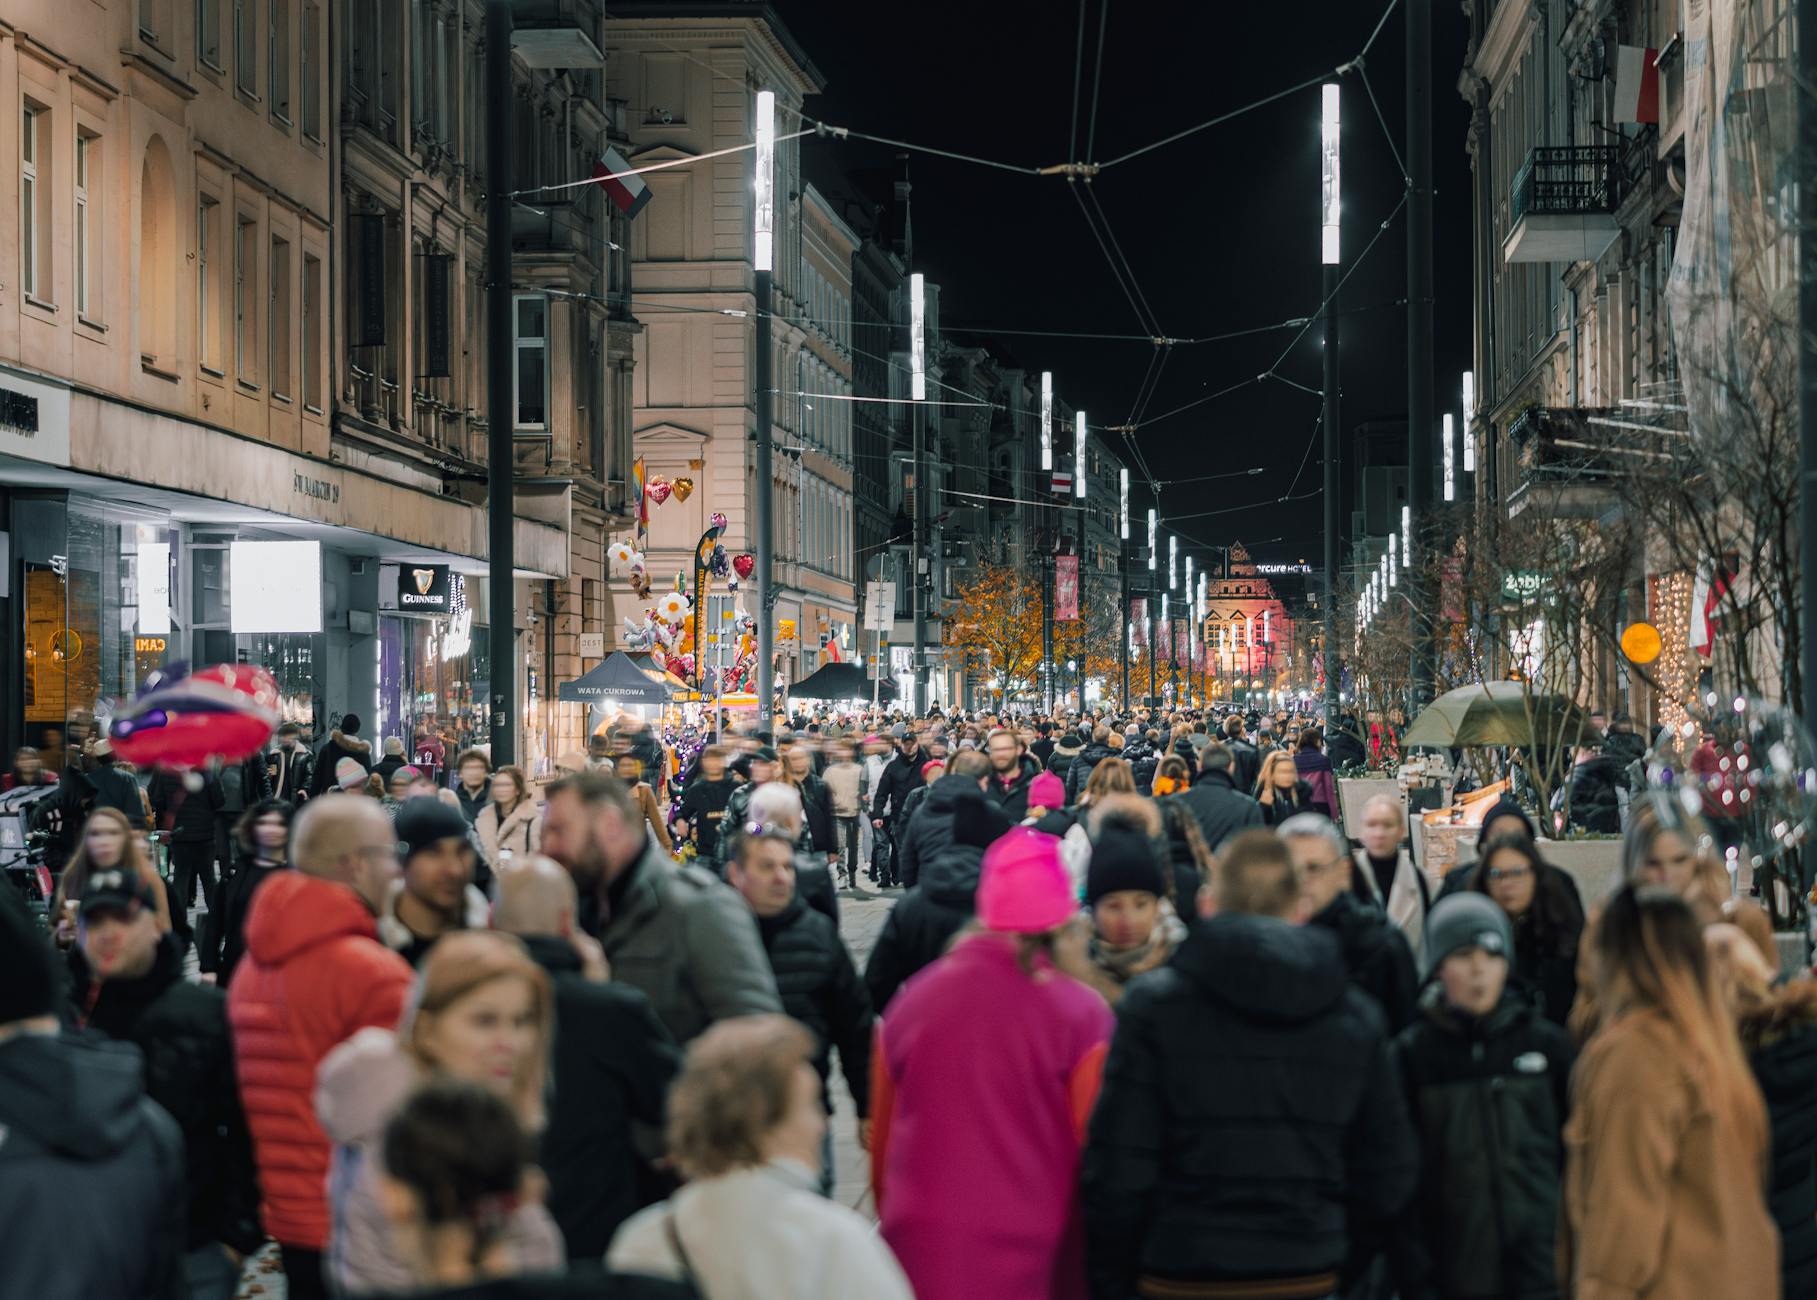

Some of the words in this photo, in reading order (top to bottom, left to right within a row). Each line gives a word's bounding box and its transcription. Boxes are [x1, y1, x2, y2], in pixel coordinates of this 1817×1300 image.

[402, 593, 443, 604] GUINNESS
[577, 687, 602, 695] WATA
[603, 687, 645, 696] CUKROWA
